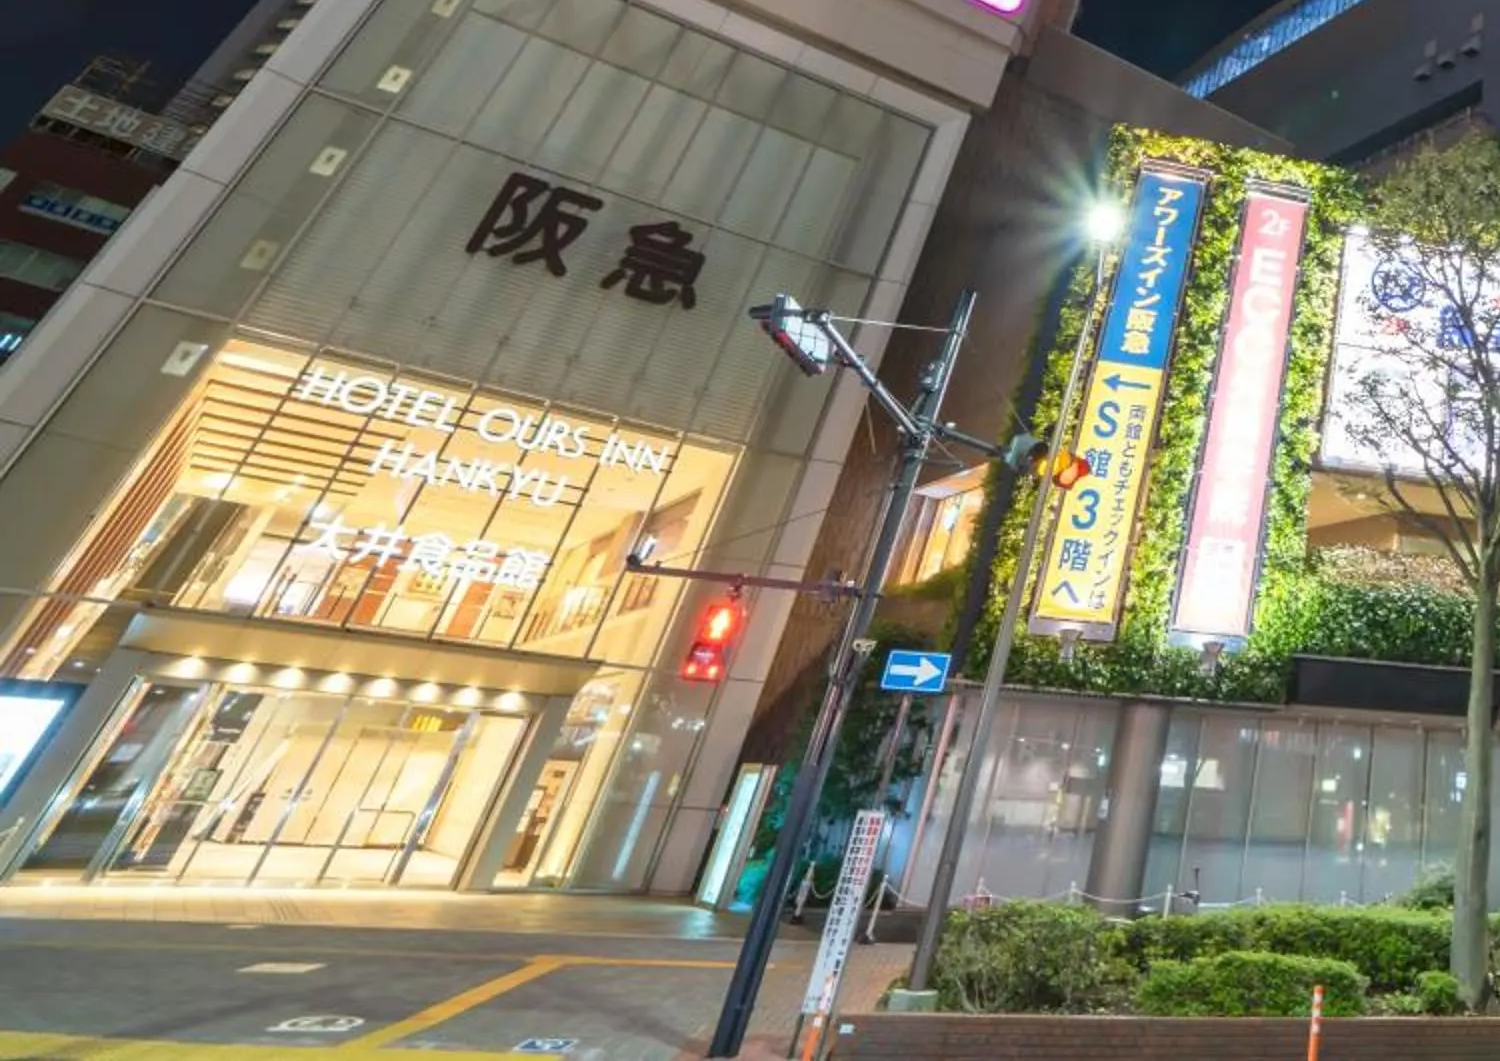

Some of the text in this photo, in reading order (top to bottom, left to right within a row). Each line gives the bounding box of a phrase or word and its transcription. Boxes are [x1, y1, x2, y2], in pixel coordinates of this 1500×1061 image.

[52, 93, 195, 156] 土地建
[465, 172, 706, 310] 阪急
[1260, 208, 1290, 236] 2F
[300, 367, 670, 476] HOTEL OURS INN
[368, 439, 570, 508] HANKYU
[1050, 399, 1122, 606] S館3階へ
[303, 515, 550, 587] 大井食品館
